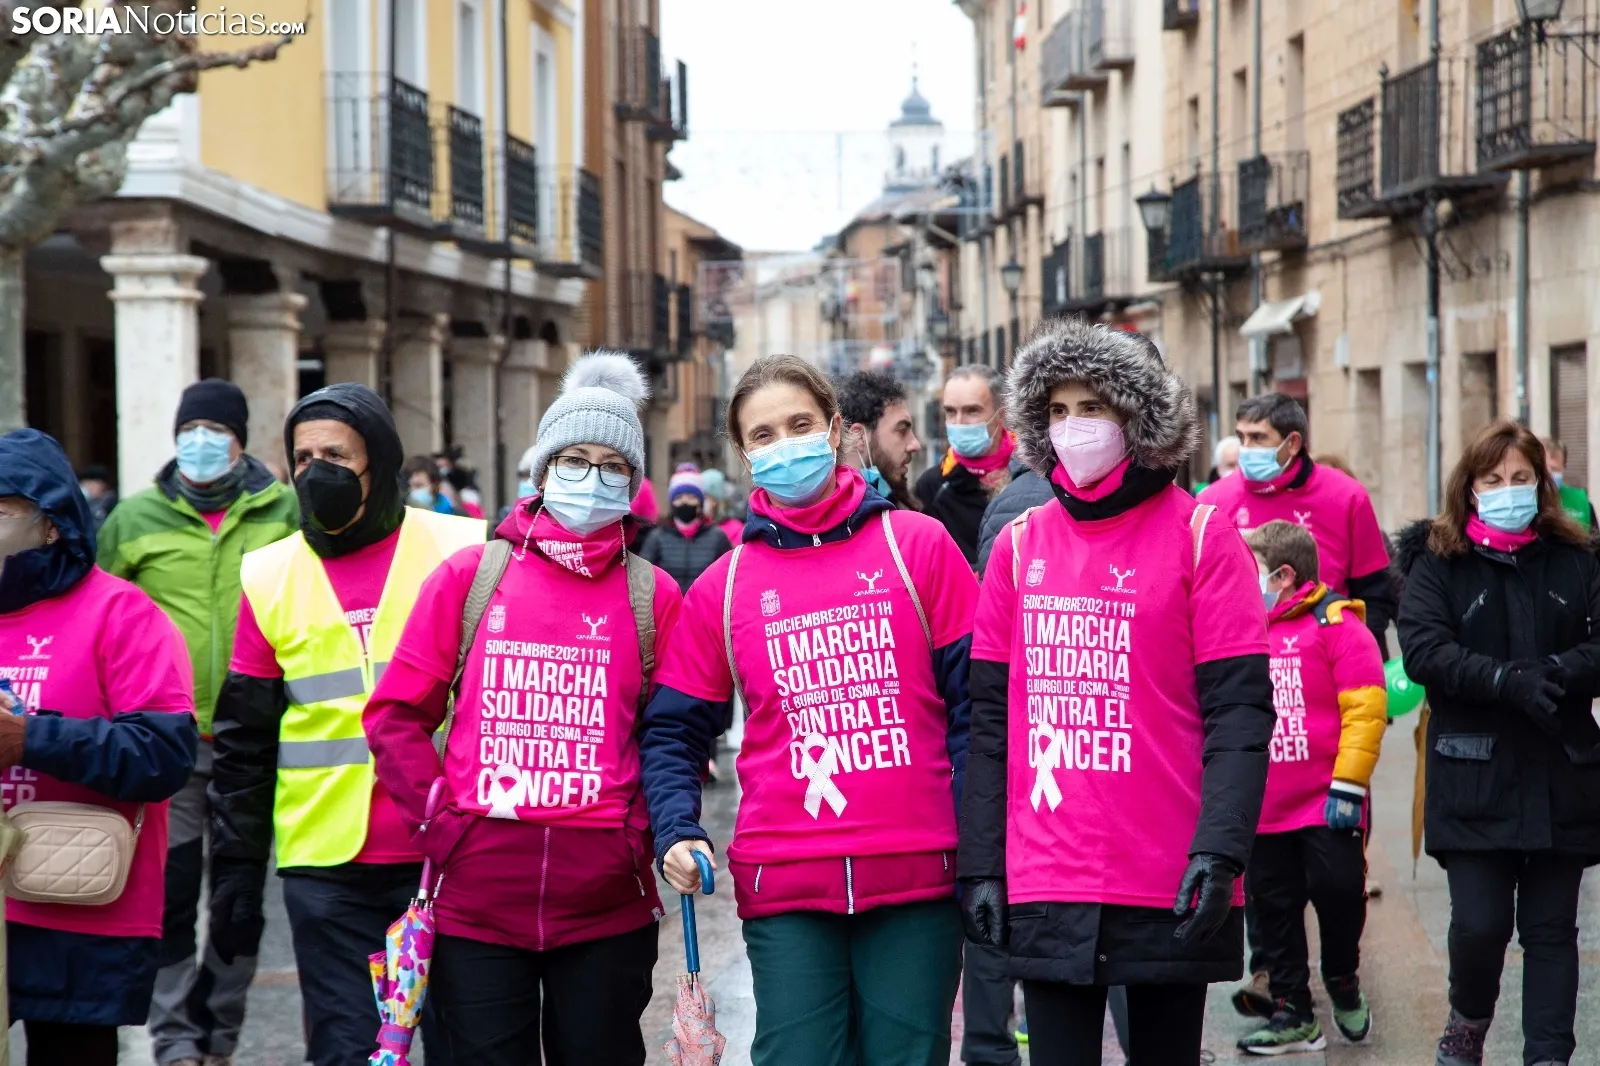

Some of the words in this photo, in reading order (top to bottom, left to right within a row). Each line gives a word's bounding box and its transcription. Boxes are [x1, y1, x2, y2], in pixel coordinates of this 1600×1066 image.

[766, 636, 785, 670] II
[788, 617, 896, 665] MARCHA
[1036, 613, 1132, 653] MARCHA
[483, 657, 496, 688] II
[502, 658, 608, 698] MARCHA
[773, 650, 899, 697] SOLIDARIA
[1025, 646, 1130, 683] SOLIDARIA
[781, 699, 794, 713] EL
[793, 690, 829, 709] BURGO
[830, 687, 847, 703] DE
[847, 682, 881, 700] OSMA
[1063, 680, 1077, 695] DE
[1078, 680, 1110, 697] OSMA
[481, 690, 606, 728] SOLIDARIA
[787, 699, 874, 739] CONTRA
[877, 696, 905, 725] EL
[1027, 695, 1098, 727] CONTRA
[1104, 698, 1133, 729] EL
[1288, 716, 1308, 736] EL
[480, 721, 494, 735] EL
[495, 721, 531, 737] BURGO
[533, 723, 548, 738] DE
[550, 725, 581, 742] OSMA
[480, 736, 570, 769] CONTRA
[575, 742, 603, 772] EL
